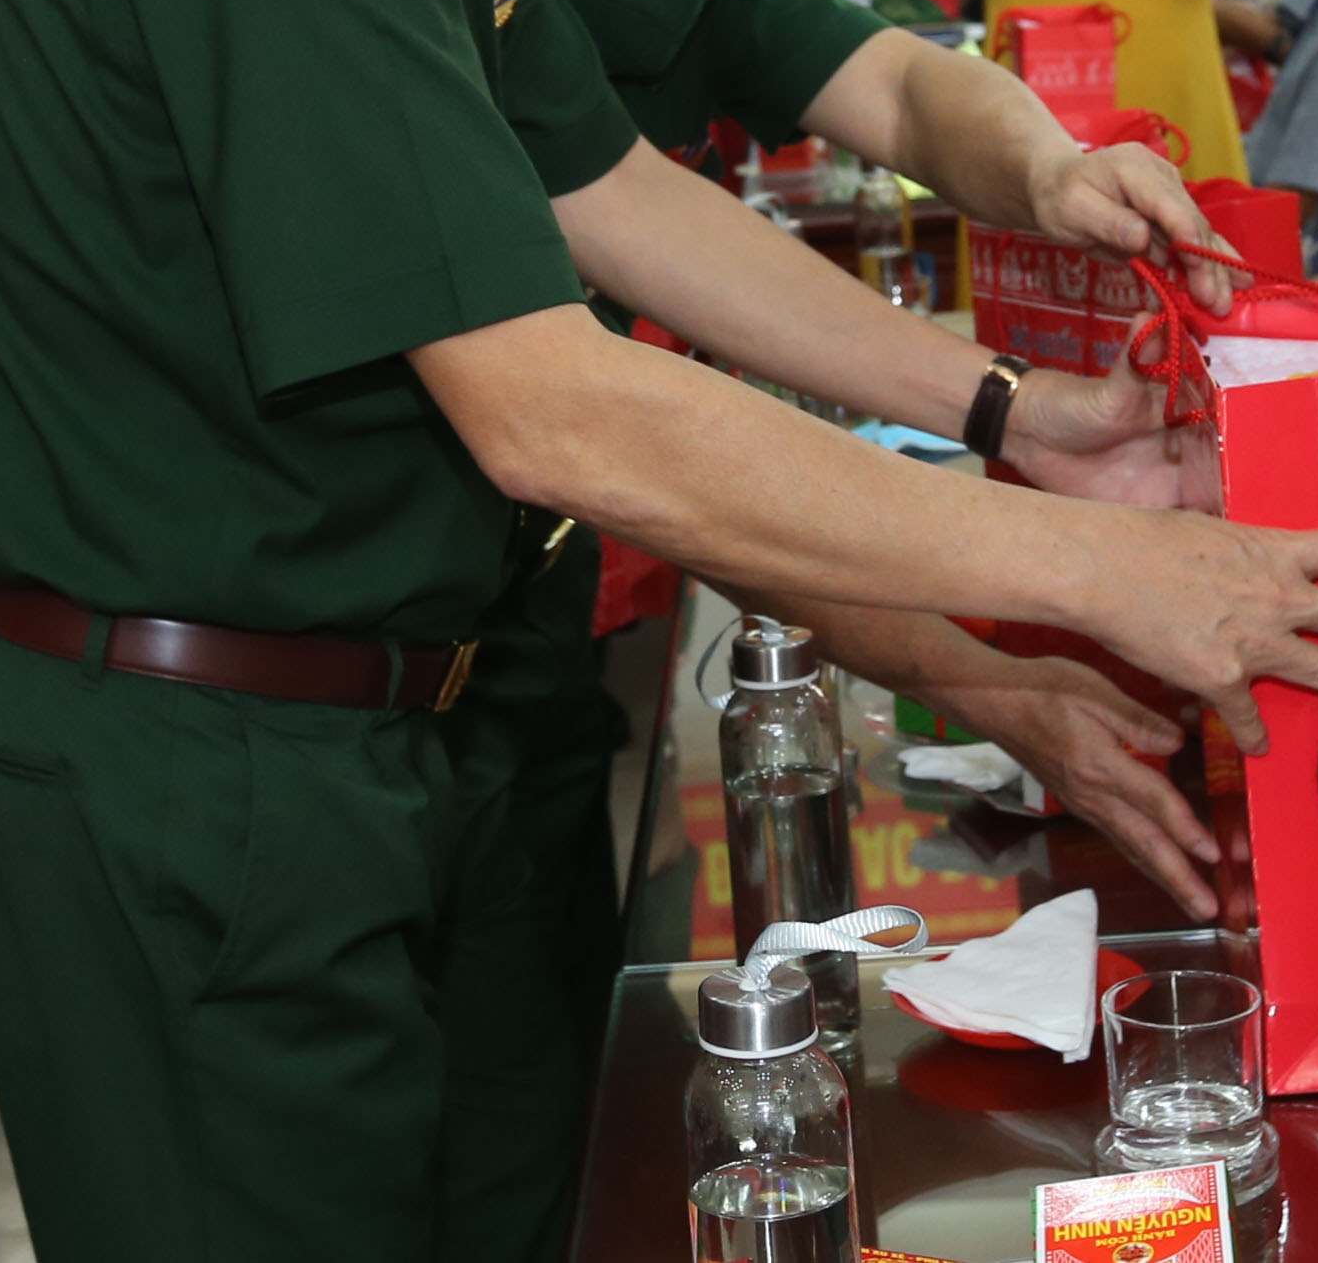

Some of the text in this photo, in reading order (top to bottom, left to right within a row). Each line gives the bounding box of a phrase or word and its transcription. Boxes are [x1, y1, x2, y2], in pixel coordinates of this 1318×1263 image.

[1053, 1206, 1213, 1242] NGUYÊN NINH
[1132, 1229, 1176, 1244] BÁNH
